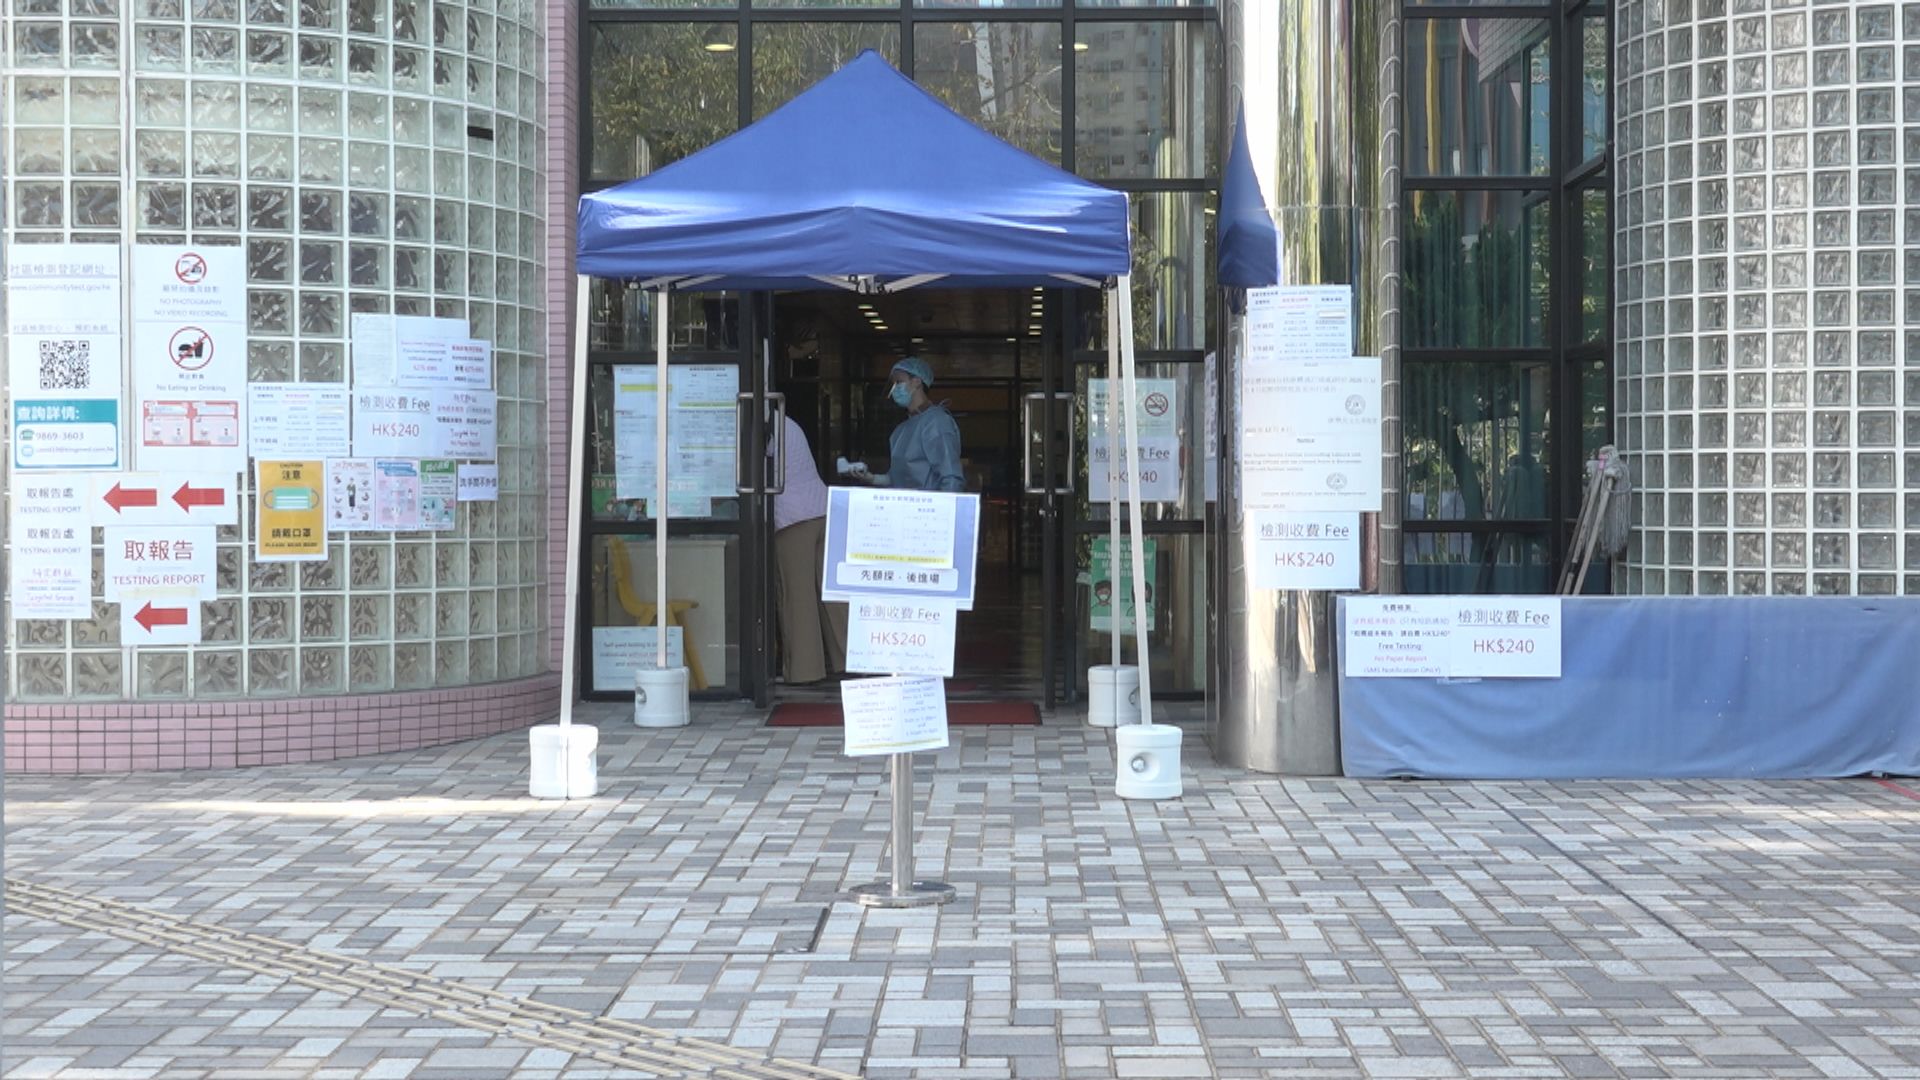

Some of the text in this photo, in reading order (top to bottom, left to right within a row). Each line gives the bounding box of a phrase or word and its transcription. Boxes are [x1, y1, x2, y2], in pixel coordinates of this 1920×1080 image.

[360, 395, 431, 411] 檢測收費 Fee
[372, 423, 420, 437] HK$240
[1149, 447, 1170, 459] Fee
[282, 470, 301, 480] 注意
[26, 488, 74, 499] 取報告處
[27, 528, 75, 540] 取報告處
[272, 528, 311, 538] 請戴口罩
[1261, 522, 1349, 537] 檢測收費 Fee
[124, 540, 193, 562] 取報告
[1275, 552, 1334, 567] HK$240
[112, 574, 206, 585] TESTING REPORT
[860, 604, 940, 621] 檢測收費 Fee
[1457, 608, 1550, 625] 檢測收費 Fee
[870, 632, 926, 647] HK$240
[1378, 642, 1422, 651] Free Testing
[1473, 638, 1534, 654] HK$240
[1386, 655, 1403, 663] Paper
[1405, 655, 1428, 663] Report
